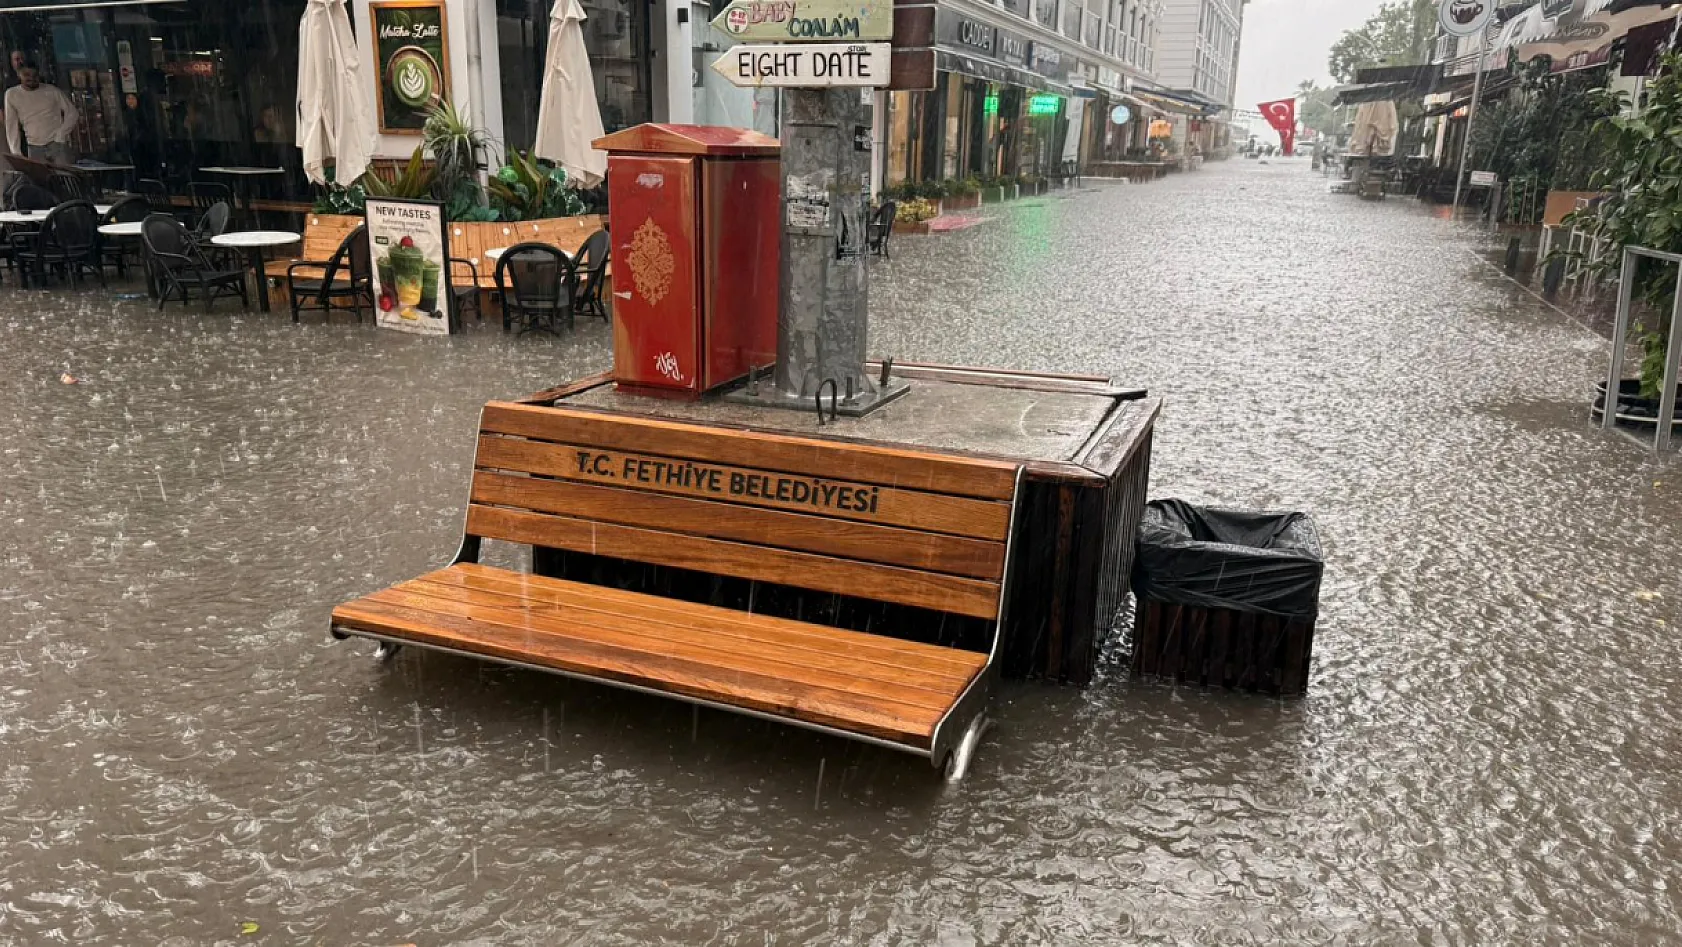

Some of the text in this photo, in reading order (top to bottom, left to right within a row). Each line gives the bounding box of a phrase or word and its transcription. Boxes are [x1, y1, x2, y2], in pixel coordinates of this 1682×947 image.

[749, 1, 797, 23] BABY
[411, 23, 439, 39] Latte
[738, 51, 872, 77] EIGHT DATE
[376, 205, 432, 220] NEW TASTES
[576, 451, 880, 514] T.C. FETHİYE BELEDİYESİ
